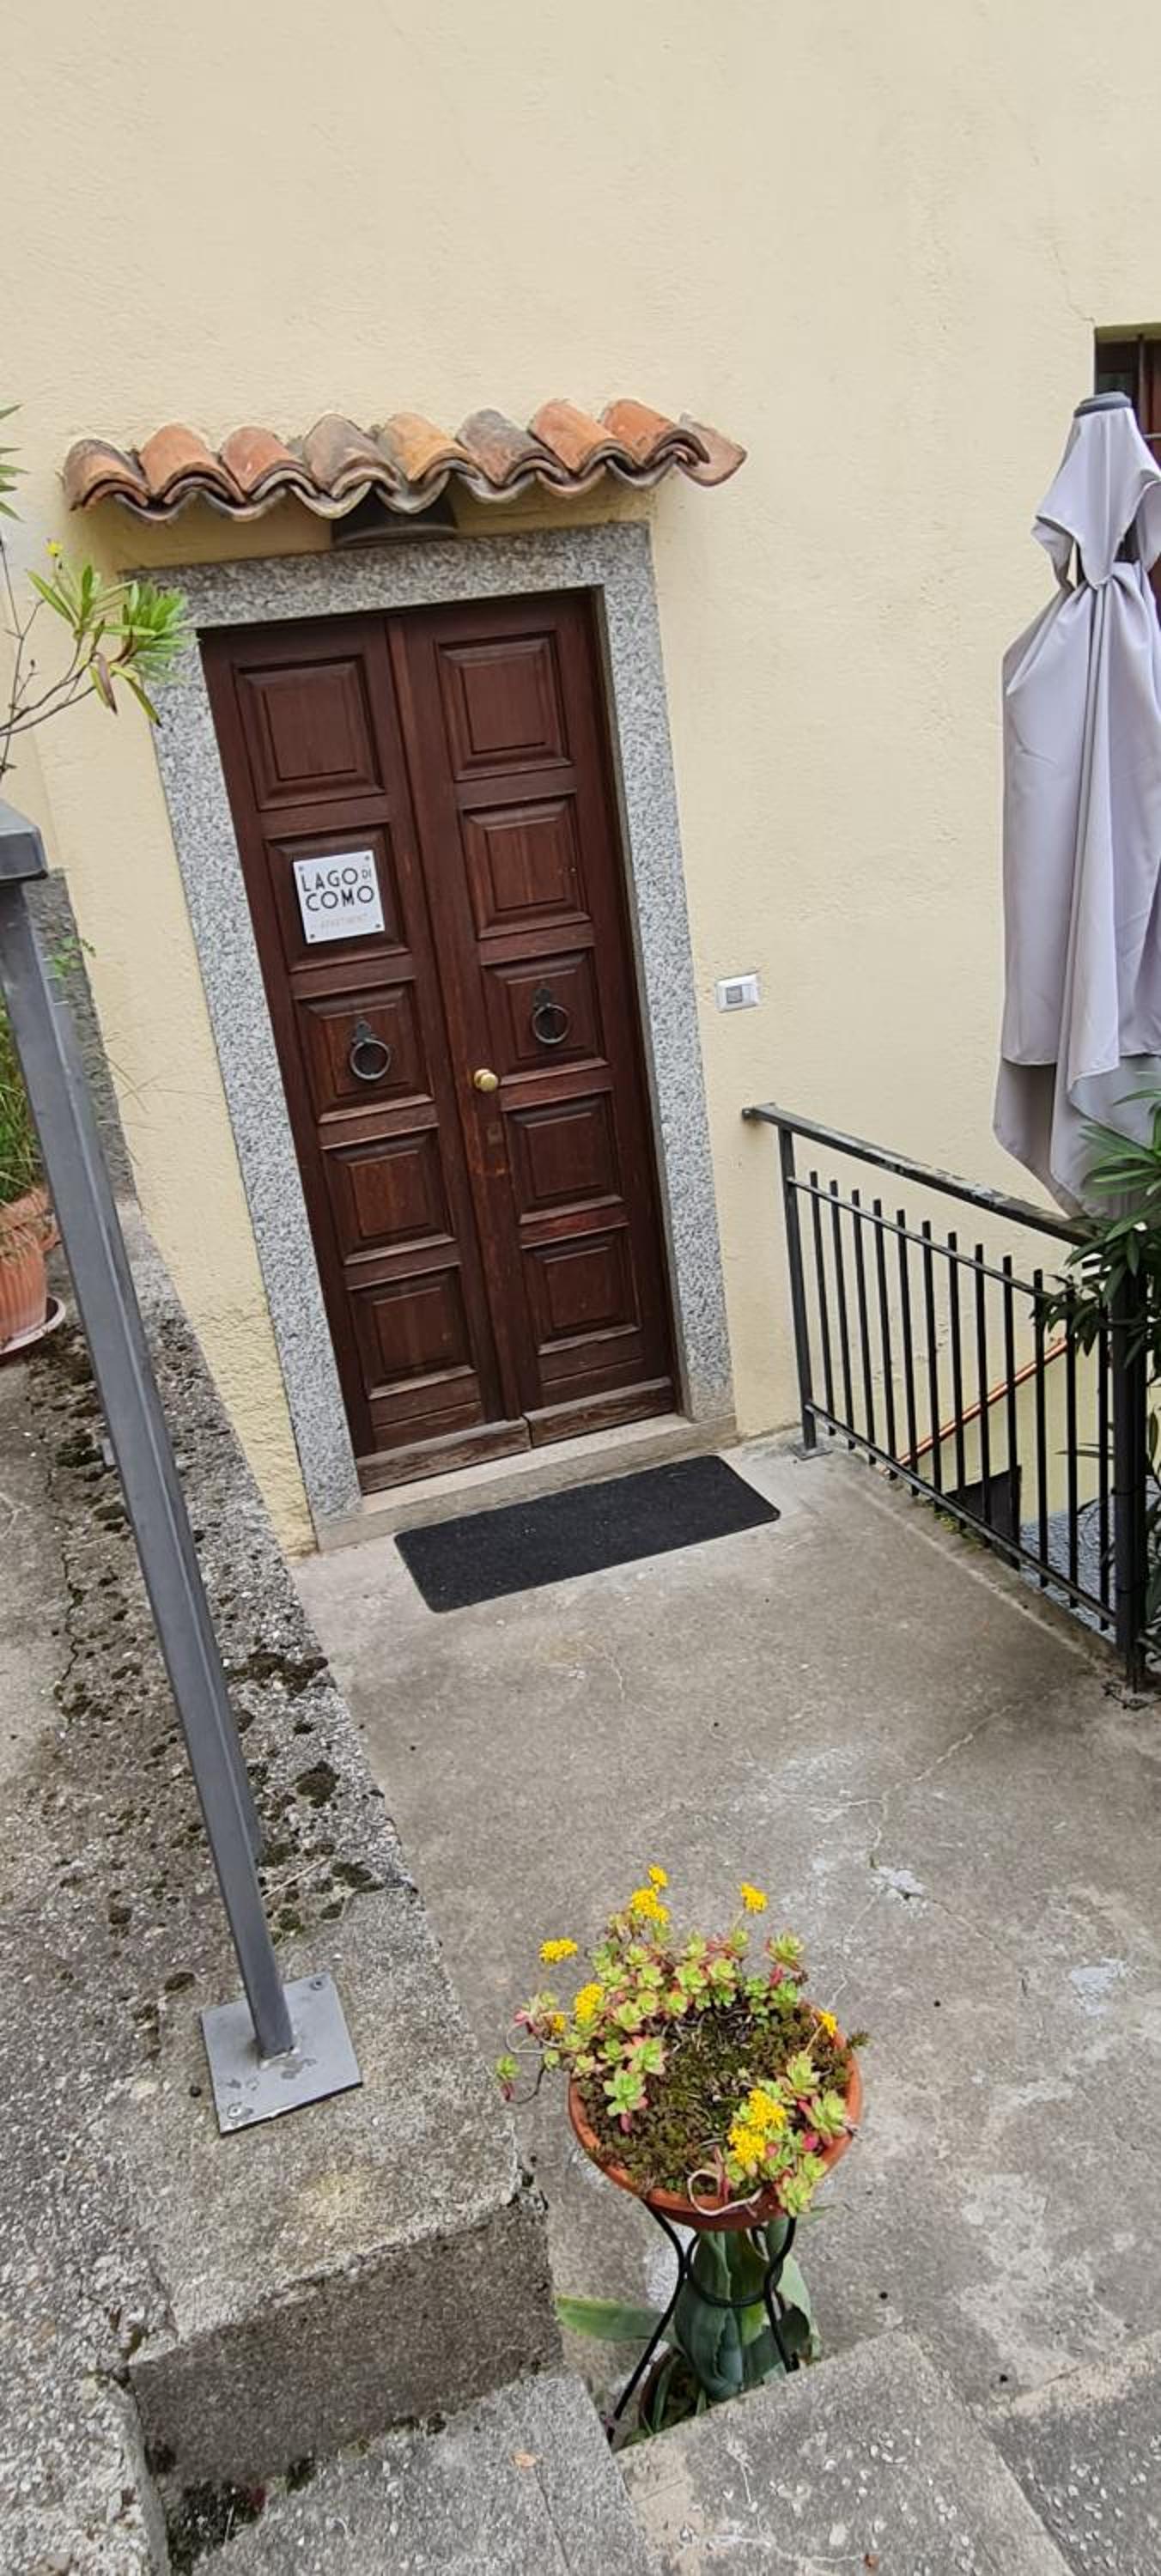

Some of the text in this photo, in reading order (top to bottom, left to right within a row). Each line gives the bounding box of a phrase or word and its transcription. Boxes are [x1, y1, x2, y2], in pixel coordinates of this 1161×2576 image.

[301, 867, 372, 892] LAGO DI
[306, 885, 374, 911] COMO
